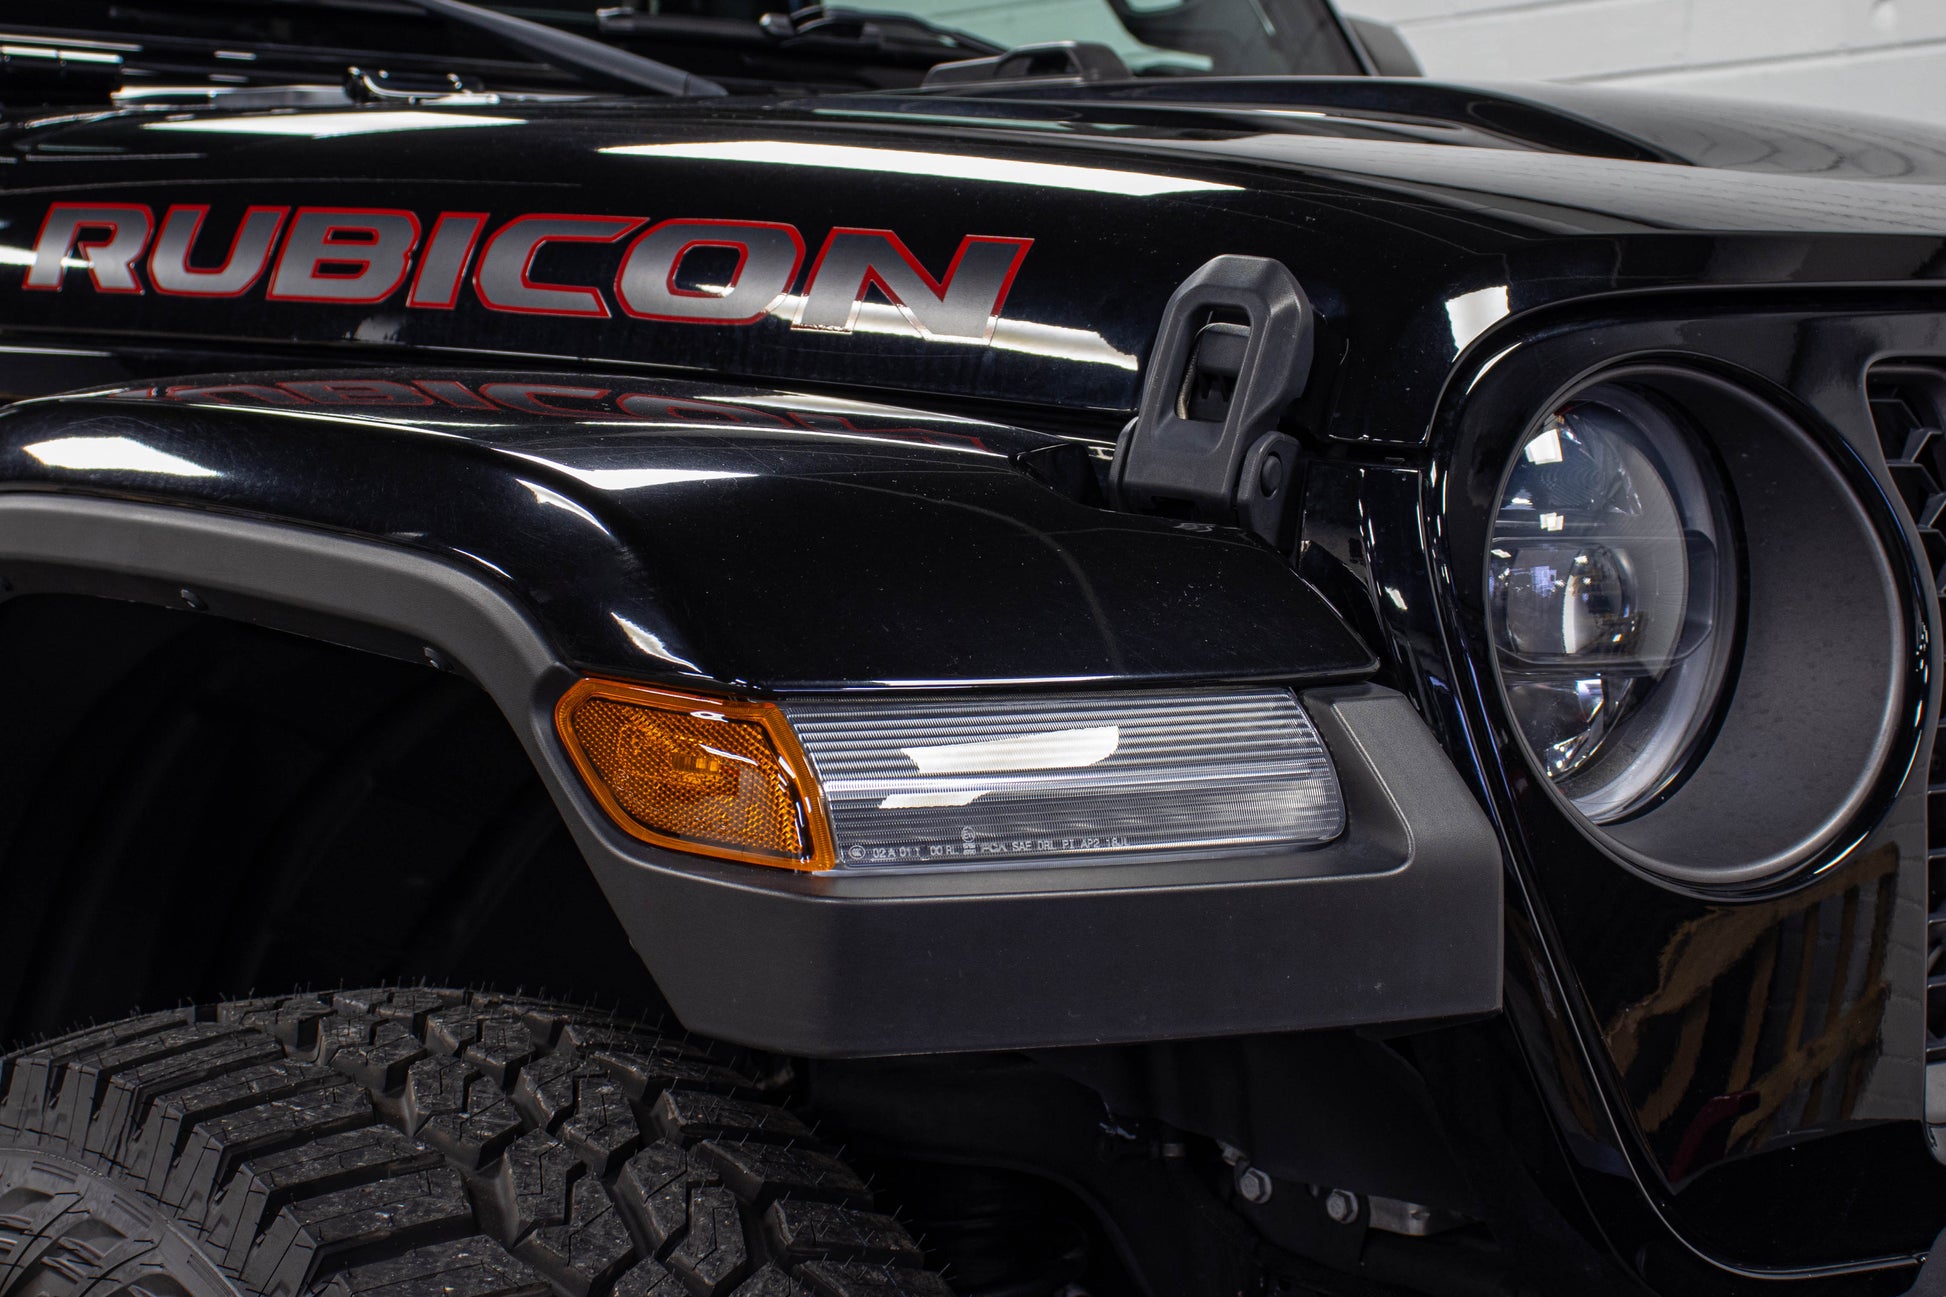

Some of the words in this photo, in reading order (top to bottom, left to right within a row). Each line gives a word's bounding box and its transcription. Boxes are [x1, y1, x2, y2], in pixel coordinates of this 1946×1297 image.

[22, 201, 1035, 346] RUBICON
[1012, 841, 1031, 851] SAE
[1037, 840, 1056, 850] DRL
